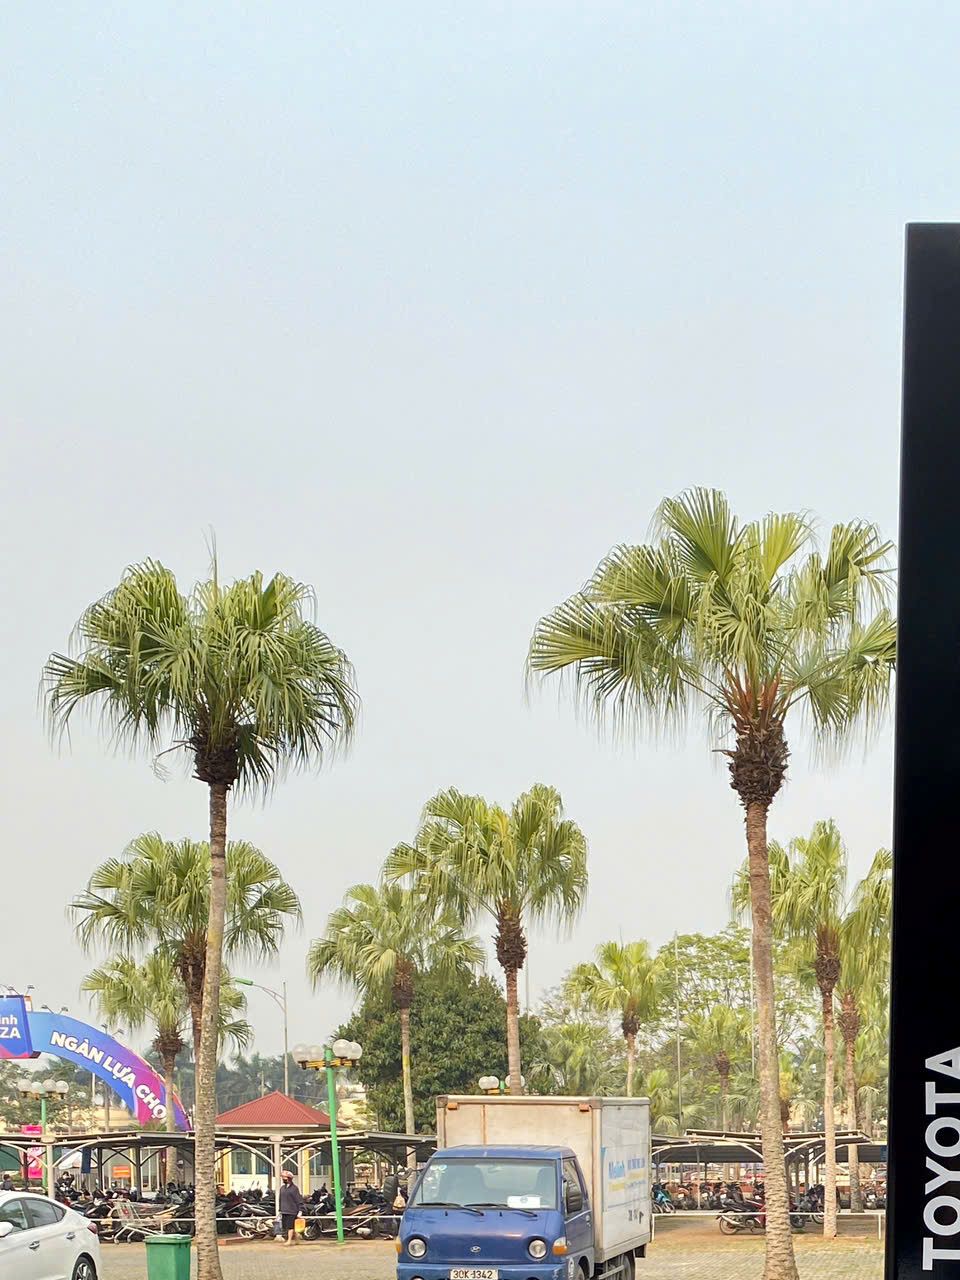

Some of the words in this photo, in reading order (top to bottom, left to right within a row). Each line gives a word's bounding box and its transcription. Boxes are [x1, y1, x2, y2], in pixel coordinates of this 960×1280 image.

[50, 1031, 105, 1064] NGÀN
[102, 1056, 137, 1089] LỰA
[135, 1084, 167, 1120] CHỌ
